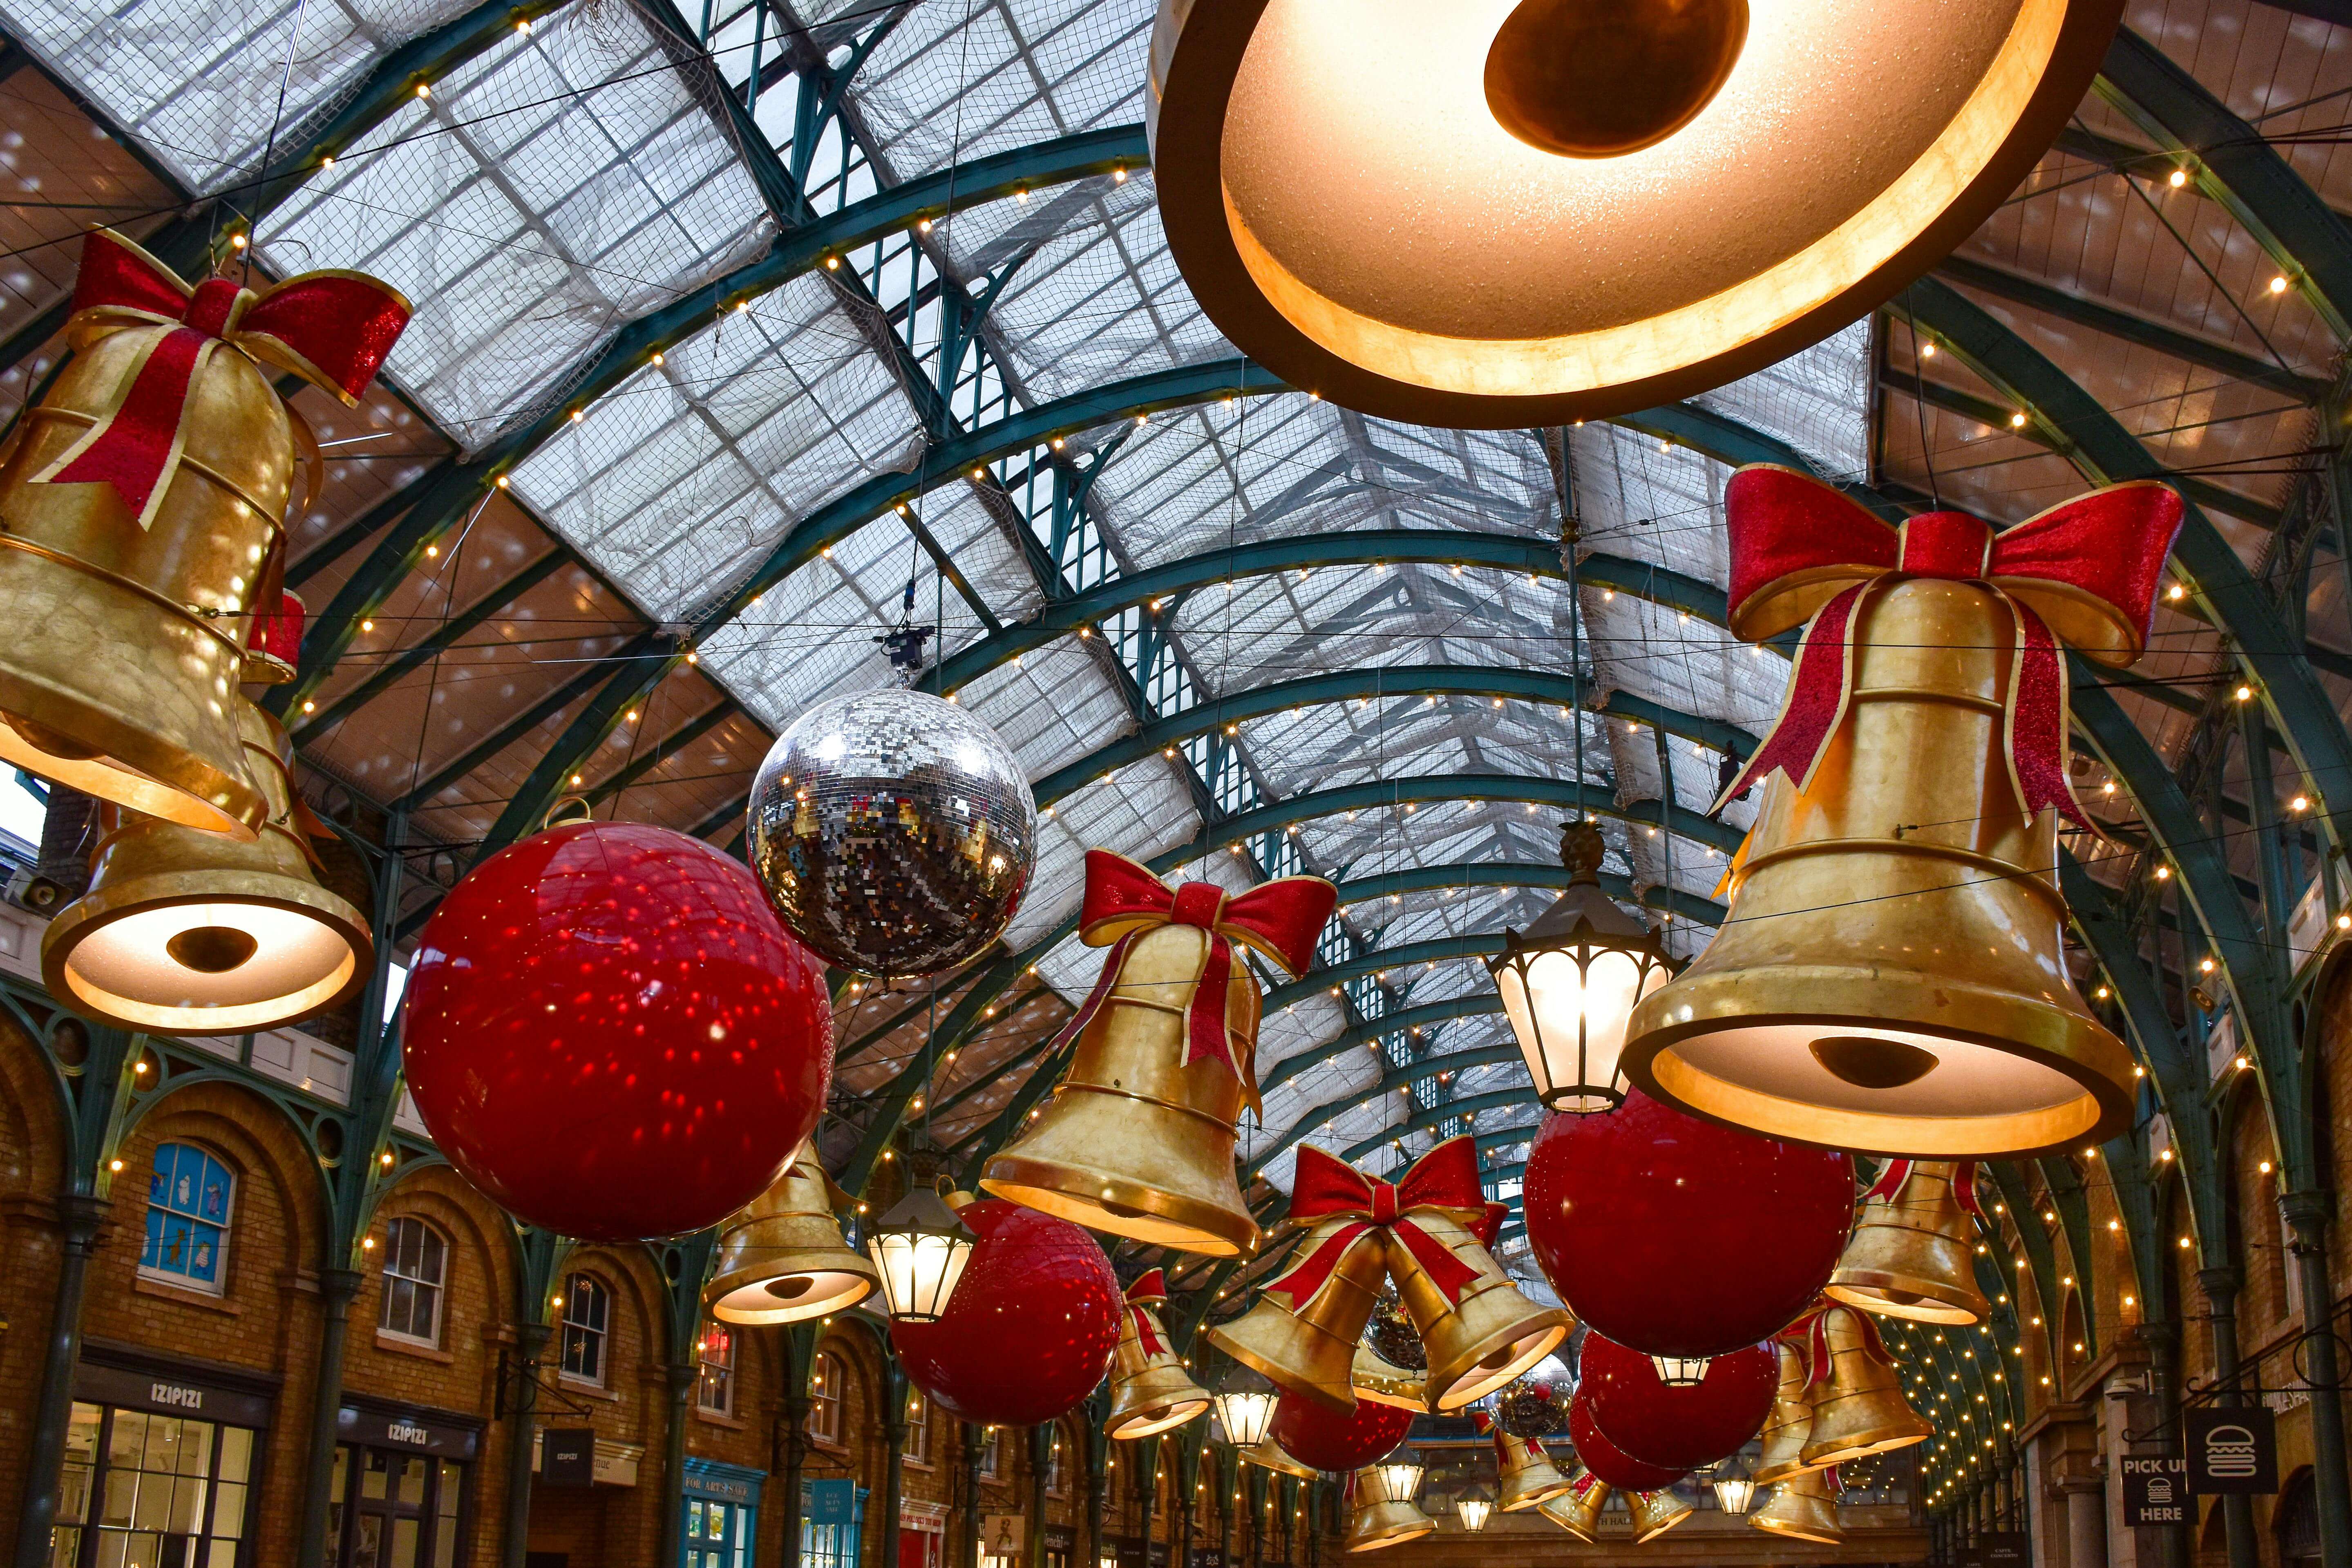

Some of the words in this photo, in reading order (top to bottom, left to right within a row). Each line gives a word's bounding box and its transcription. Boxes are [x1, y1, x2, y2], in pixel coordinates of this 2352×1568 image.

[152, 1383, 201, 1409] IZIPIZI
[389, 1424, 427, 1445] IZIPIZI
[2124, 1460, 2163, 1473] PICK
[686, 1477, 700, 1489] FOR
[2140, 1508, 2182, 1521] HERE
